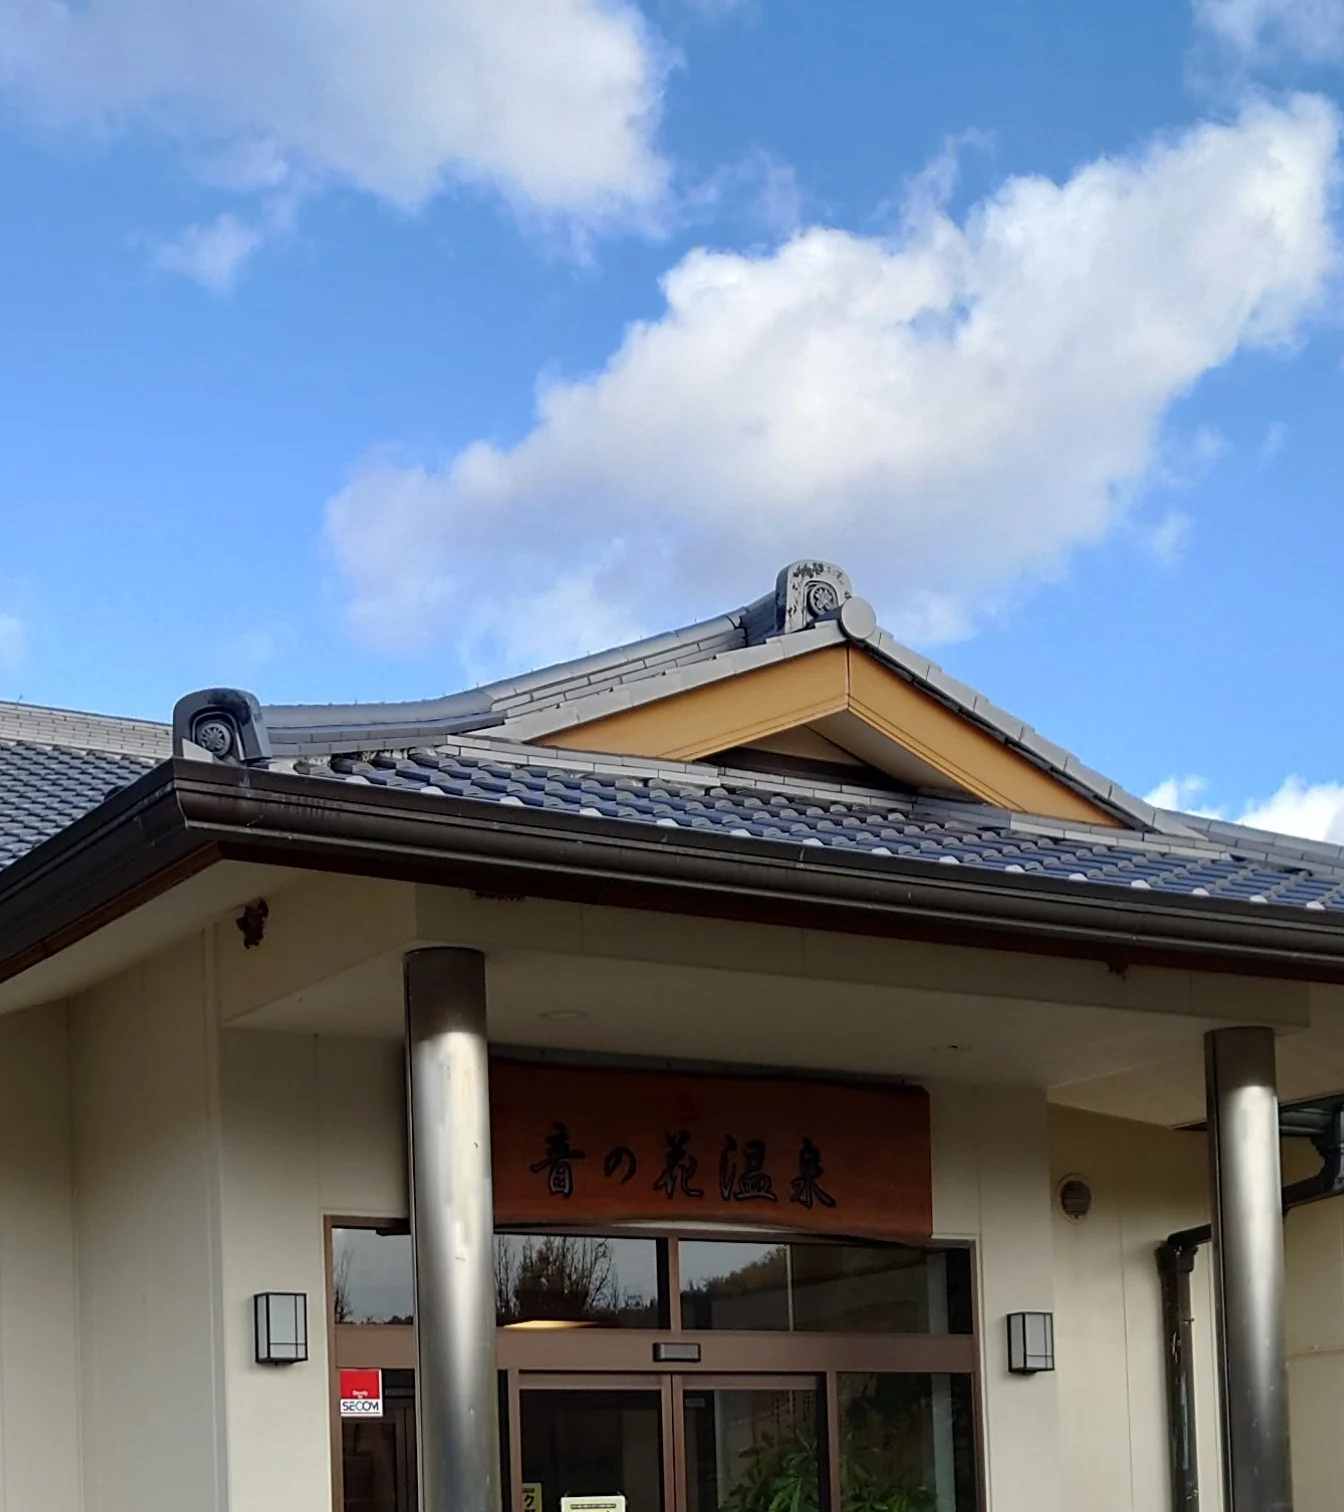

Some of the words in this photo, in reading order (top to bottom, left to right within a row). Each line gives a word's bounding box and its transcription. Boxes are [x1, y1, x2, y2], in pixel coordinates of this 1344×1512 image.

[529, 1121, 837, 1209] 音の花温泉
[342, 1401, 379, 1411] SECOM
